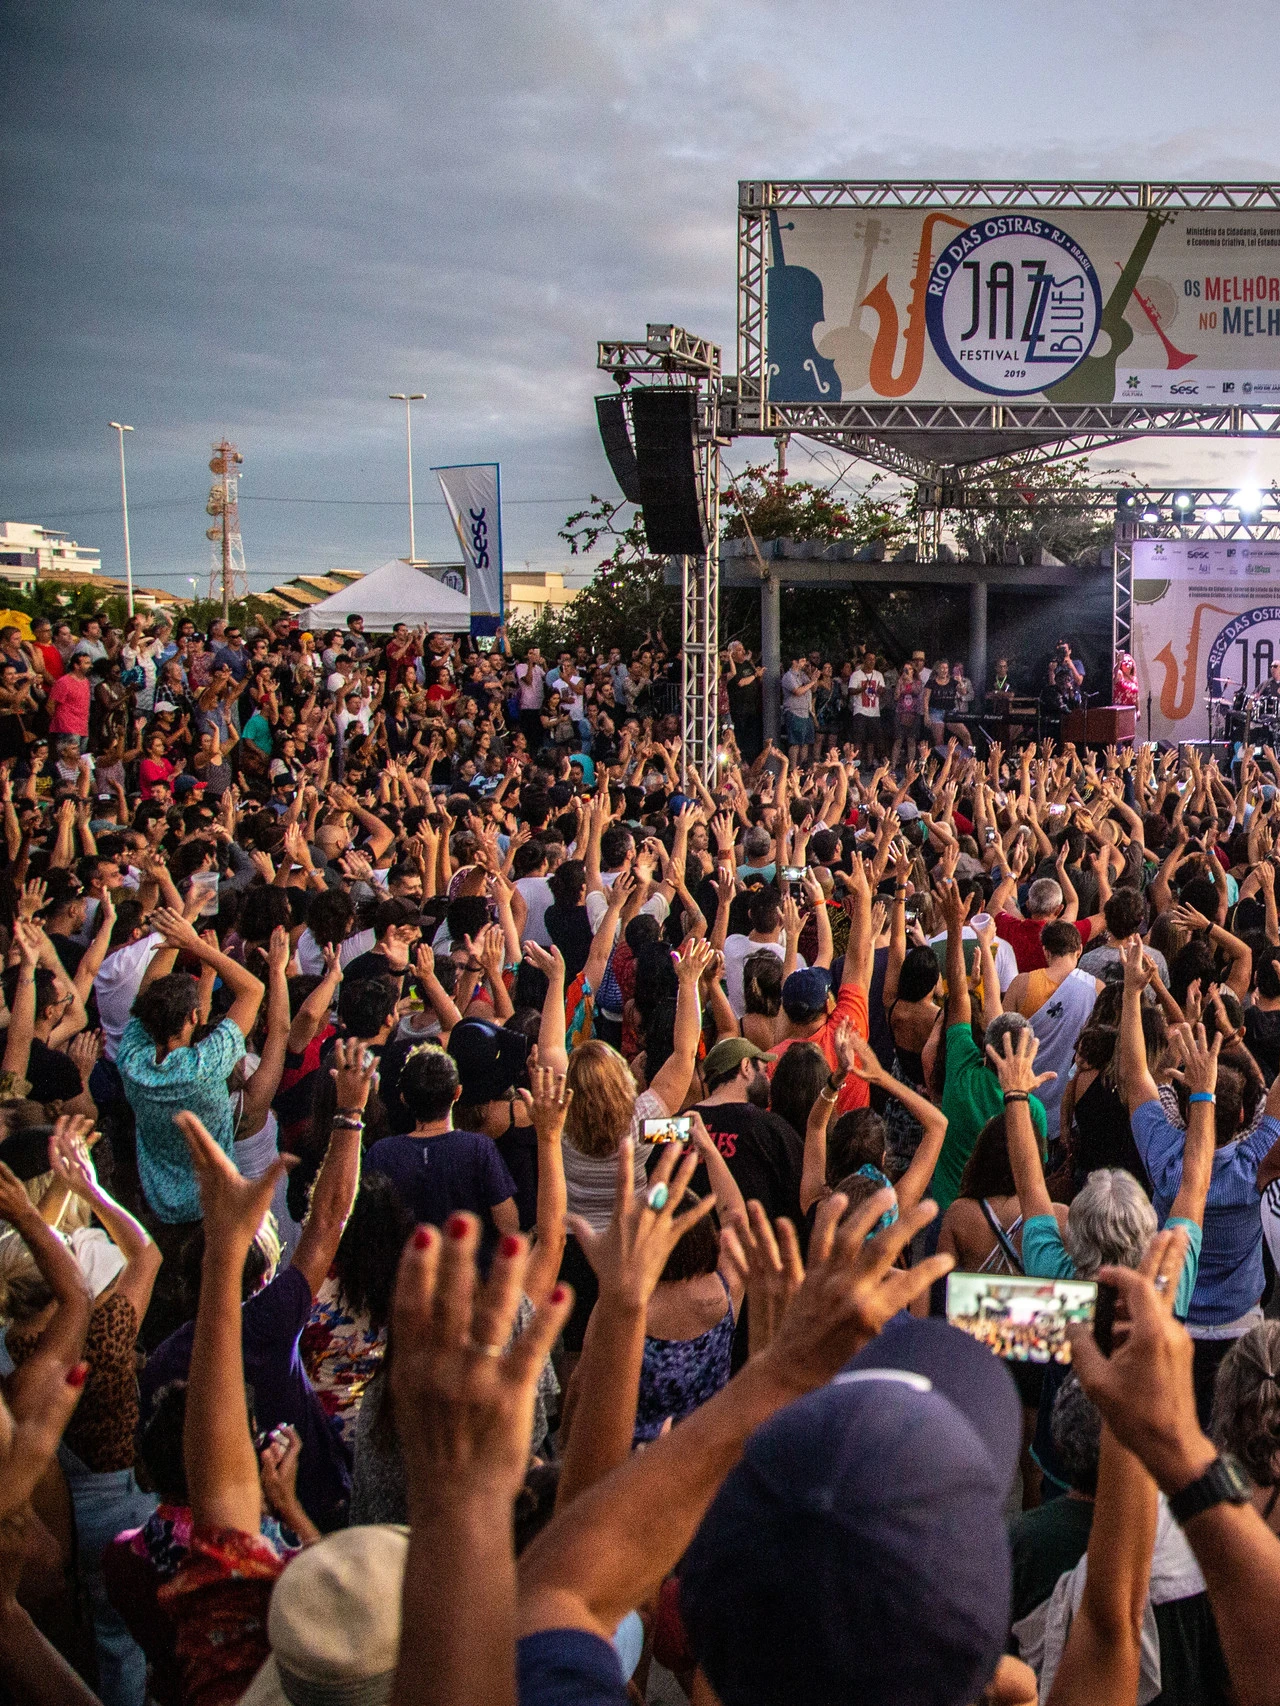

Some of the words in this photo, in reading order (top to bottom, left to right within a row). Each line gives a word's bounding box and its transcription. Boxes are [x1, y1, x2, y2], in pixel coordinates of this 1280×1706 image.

[1186, 227, 1217, 236] Ministério
[1217, 227, 1226, 236] da
[1226, 227, 1259, 237] Cidadania,
[1192, 238, 1221, 246] Economia
[1247, 238, 1257, 246] Lei
[929, 262, 952, 297] RIO
[949, 229, 982, 262] DAS
[985, 217, 1042, 237] OSTRAS
[1050, 230, 1067, 244] RJ
[1070, 246, 1091, 272] BRASIL
[1184, 279, 1201, 298] OS
[1050, 274, 1084, 353] BLUES
[1200, 311, 1217, 330] NO
[960, 350, 1020, 361] FESTIVAL
[1004, 370, 1027, 378] 2019
[1225, 616, 1250, 639] DAS
